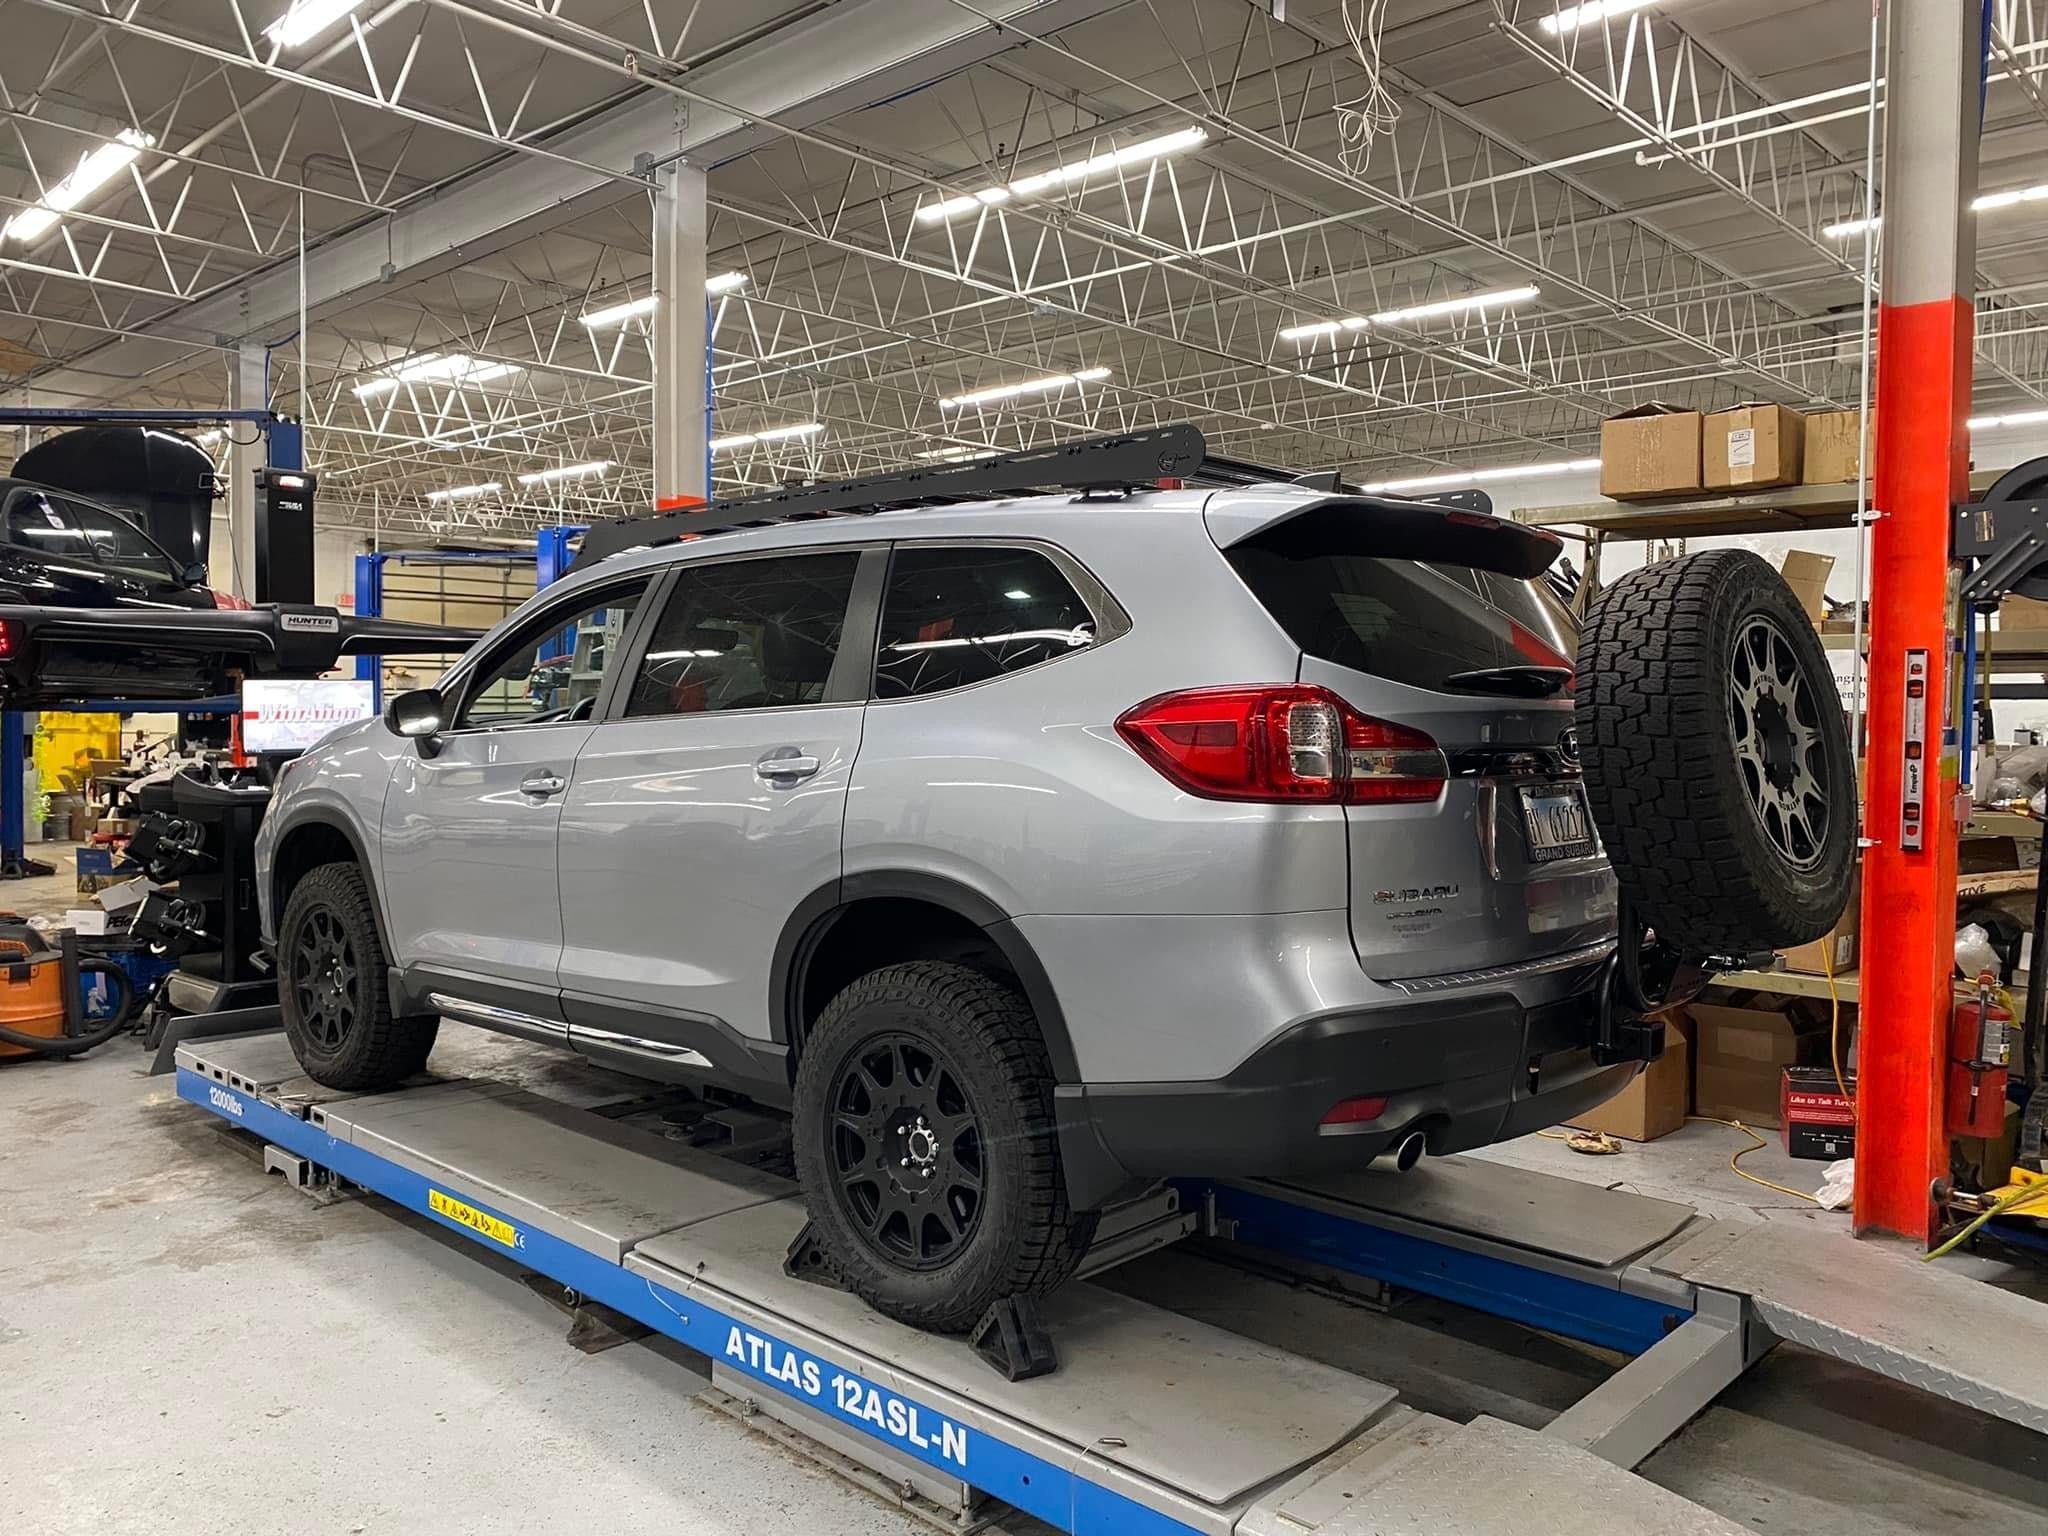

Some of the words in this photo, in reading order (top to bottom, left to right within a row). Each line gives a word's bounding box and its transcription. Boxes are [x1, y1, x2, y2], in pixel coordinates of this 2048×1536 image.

[288, 616, 333, 625] HUNTER
[1535, 848, 1564, 862] GRAND
[1565, 842, 1595, 857] SUBARU
[1374, 884, 1459, 903] SUBARU
[725, 1326, 821, 1396] ATLAS
[831, 1373, 967, 1467] 12ASL-N
